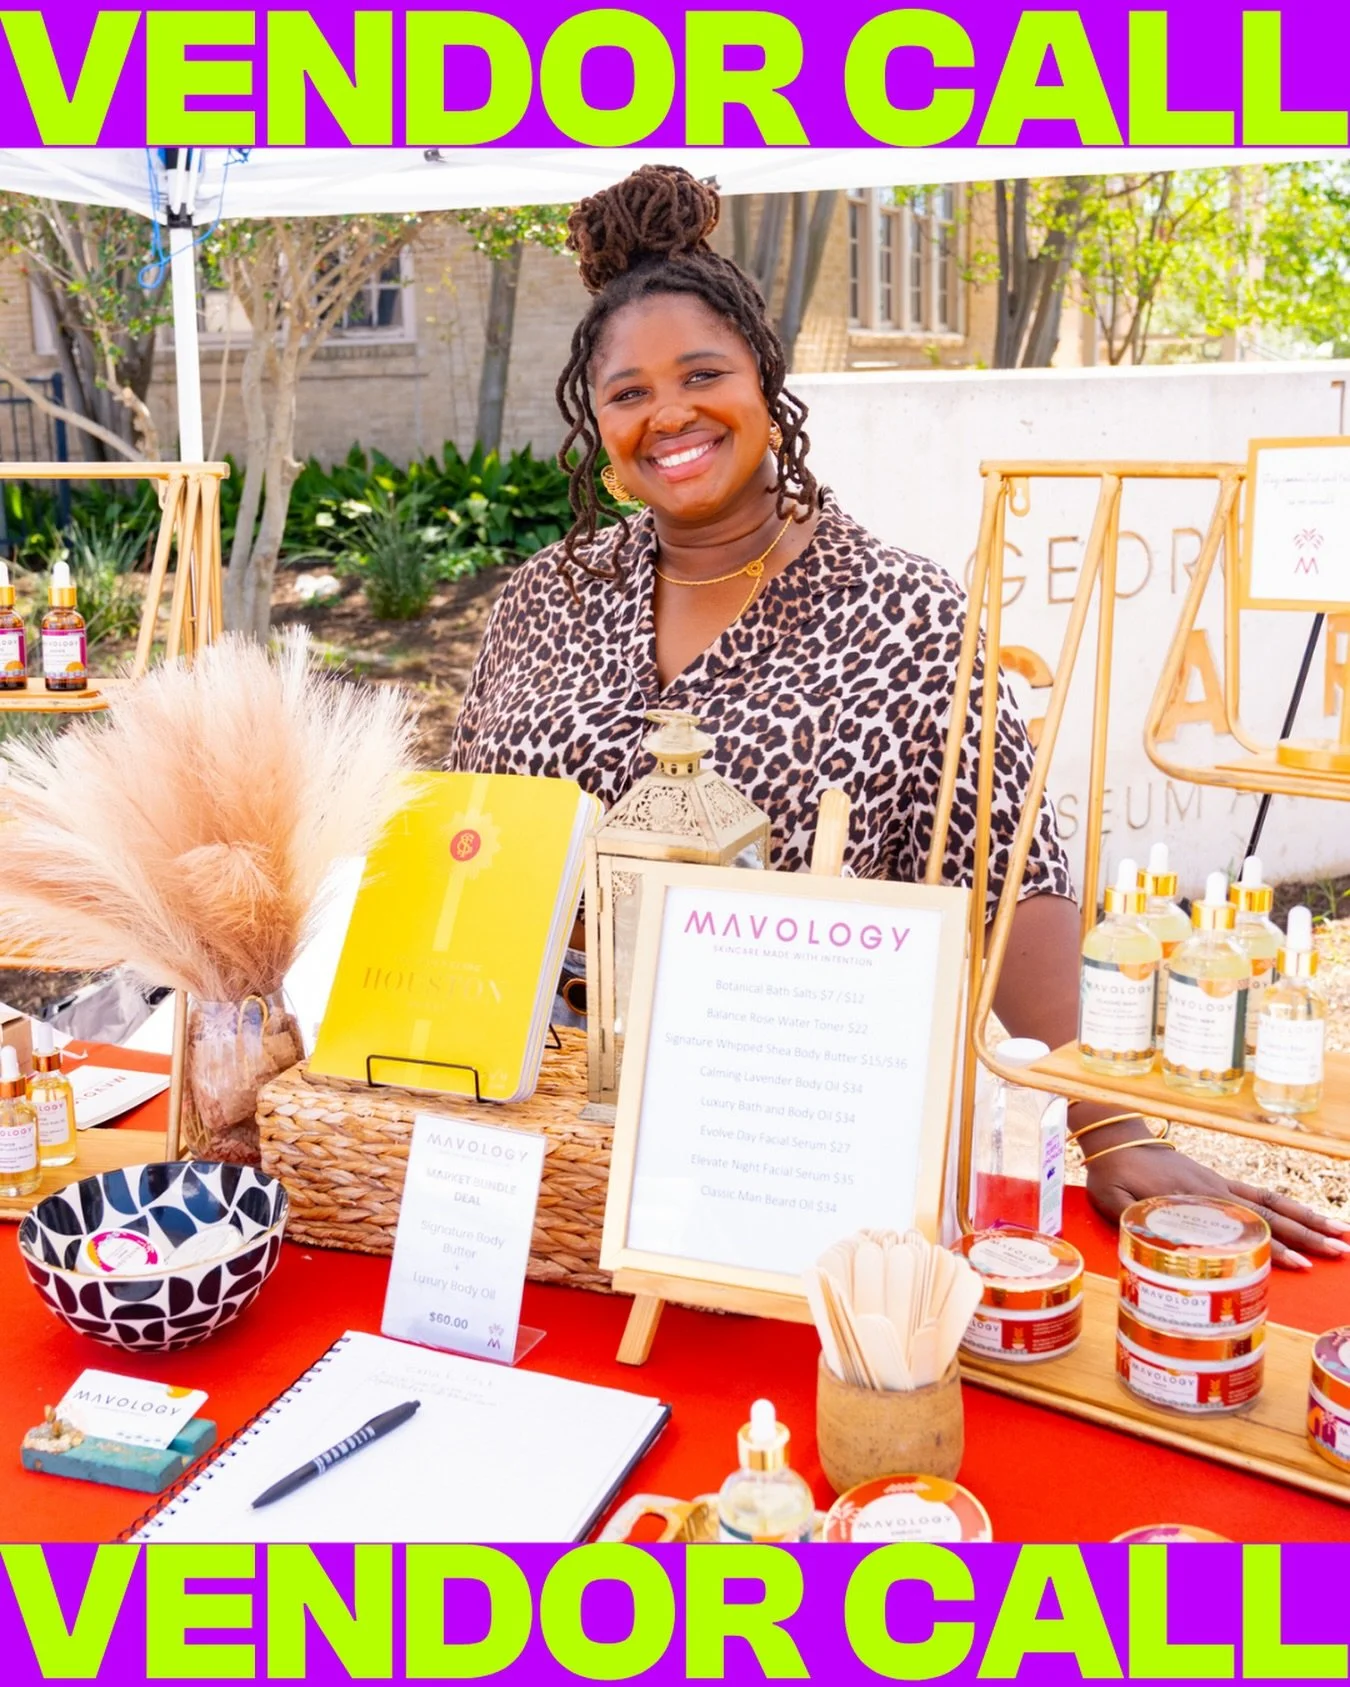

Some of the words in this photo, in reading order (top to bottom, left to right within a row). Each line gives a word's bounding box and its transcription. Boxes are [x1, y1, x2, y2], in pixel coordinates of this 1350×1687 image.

[684, 910, 911, 952] MAVOLOGY
[763, 948, 789, 960] MADE
[793, 952, 818, 963] WITH
[821, 954, 873, 967] INTENTION
[715, 979, 764, 995] Botanical
[766, 984, 790, 997] Bath
[792, 987, 818, 1000] Salts
[820, 989, 835, 1003] $7
[706, 1007, 747, 1022] Balance
[749, 1012, 775, 1025] Rose
[777, 1015, 810, 1029] Water
[813, 1018, 845, 1032] Toner
[847, 1021, 869, 1035] $22
[665, 1032, 714, 1049] Signature
[716, 1037, 763, 1054] Whipped
[766, 1043, 791, 1057] Shea
[794, 1046, 821, 1062] Body
[824, 1050, 858, 1065] Butter
[699, 1066, 742, 1083] Calming
[744, 1071, 792, 1087] Lavender
[795, 1076, 822, 1092] Body
[824, 1079, 840, 1092] Oil
[842, 1082, 864, 1095] $34
[700, 1096, 737, 1112] Luxury
[738, 1099, 762, 1113] Bath
[765, 1103, 785, 1117] and
[788, 1106, 815, 1121] Body
[817, 1109, 833, 1122] Oil
[835, 1111, 856, 1125] $34
[426, 1132, 529, 1163] MAVOLOGY
[699, 1125, 735, 1140] Evolve
[736, 1129, 757, 1145] Day
[759, 1132, 790, 1146] Facial
[792, 1136, 827, 1151] Serum
[830, 1140, 851, 1155] $27
[426, 1166, 471, 1186] MARKET
[473, 1176, 518, 1196] BUNDLE
[690, 1153, 729, 1169] Elevate
[731, 1159, 761, 1174] Night
[762, 1163, 793, 1177] Facial
[795, 1167, 830, 1182] Serum
[833, 1171, 855, 1186] $35
[454, 1191, 481, 1207] DEAL
[700, 1185, 736, 1200] Classic
[738, 1189, 762, 1204] Man
[765, 1194, 796, 1209] Beard
[799, 1198, 814, 1211] Oil
[816, 1200, 837, 1214] $34
[420, 1219, 475, 1241] Signature
[476, 1230, 506, 1250] Body
[442, 1243, 478, 1260] Butter
[413, 1271, 449, 1291] Luxury
[450, 1281, 479, 1300] Body
[481, 1286, 497, 1301] Oil
[1141, 1286, 1208, 1306] MAVOLOGY
[428, 1311, 469, 1331] $60.00
[1131, 1361, 1195, 1387] MAVOLOGY
[72, 1389, 182, 1416] MAVOLOGY
[858, 1515, 953, 1530] MAVOLOGY
